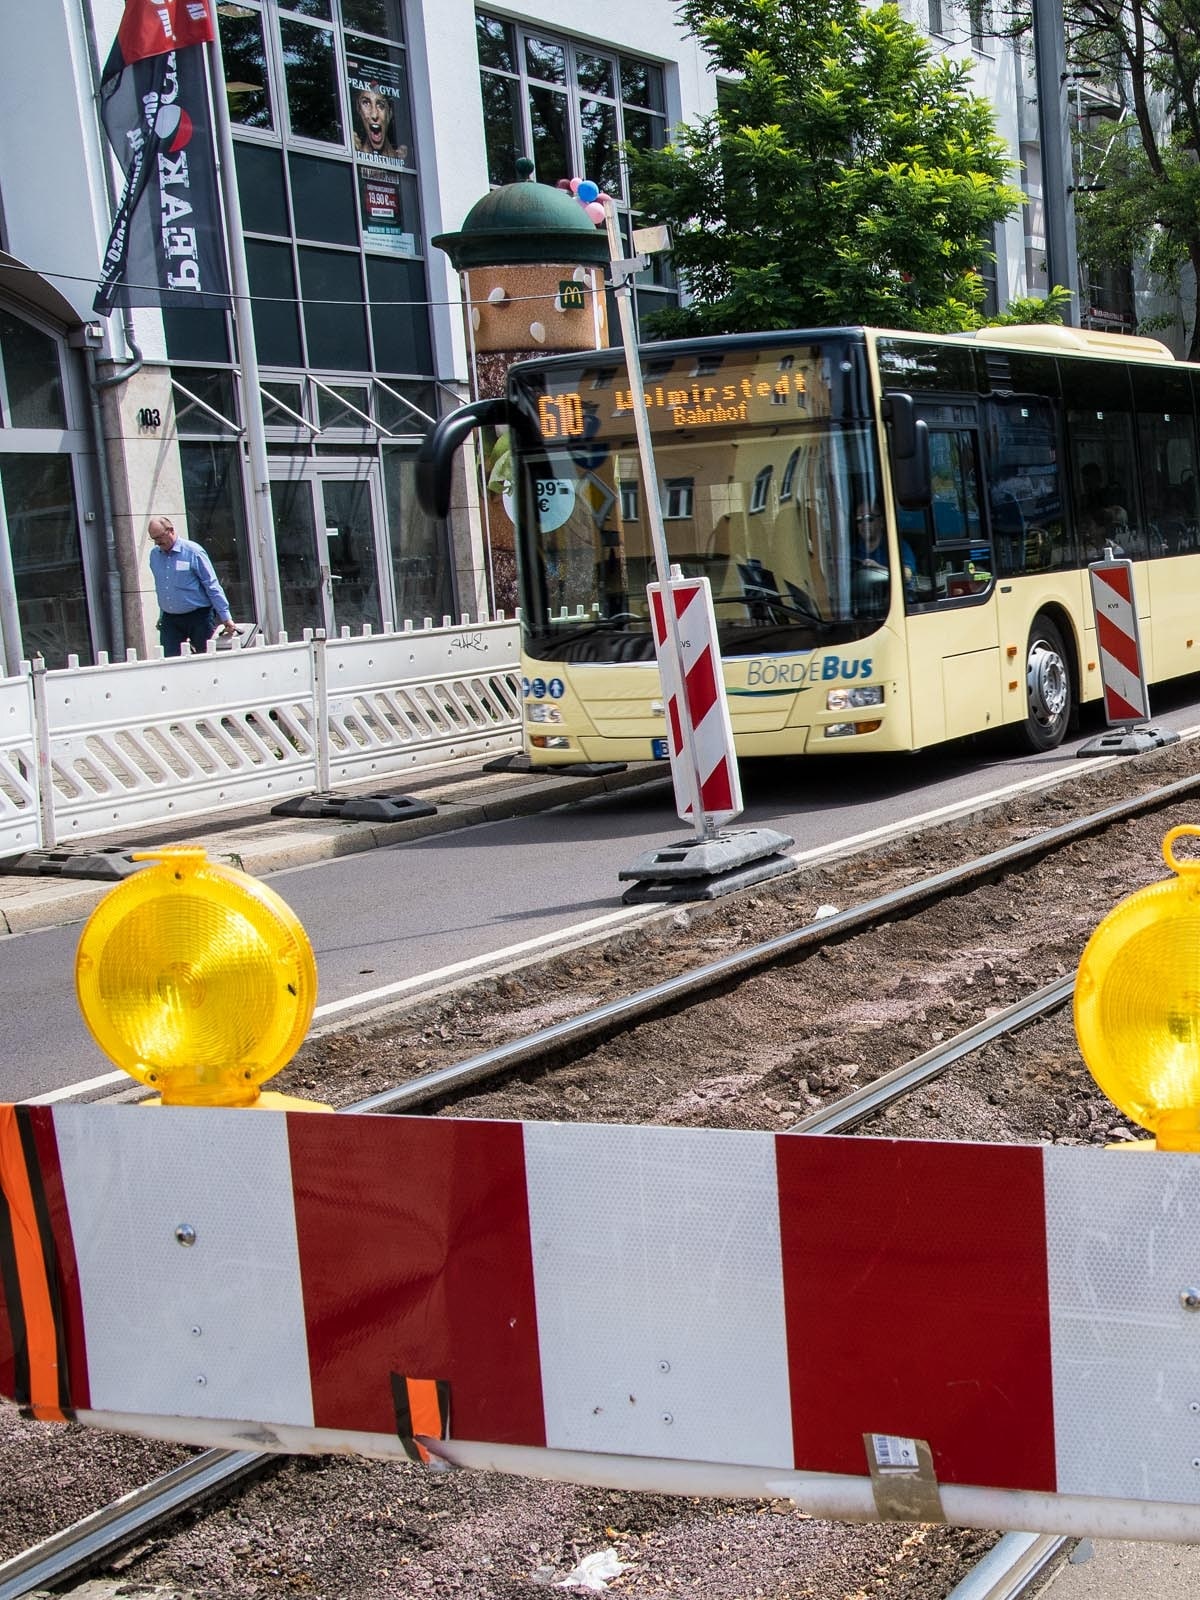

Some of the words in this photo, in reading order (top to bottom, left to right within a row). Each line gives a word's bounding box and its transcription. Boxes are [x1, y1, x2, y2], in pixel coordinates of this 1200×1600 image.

[380, 85, 400, 98] GYM
[138, 407, 161, 427] 103
[538, 393, 584, 437] 610
[673, 400, 748, 426] Bahnhof
[679, 640, 691, 649] VS
